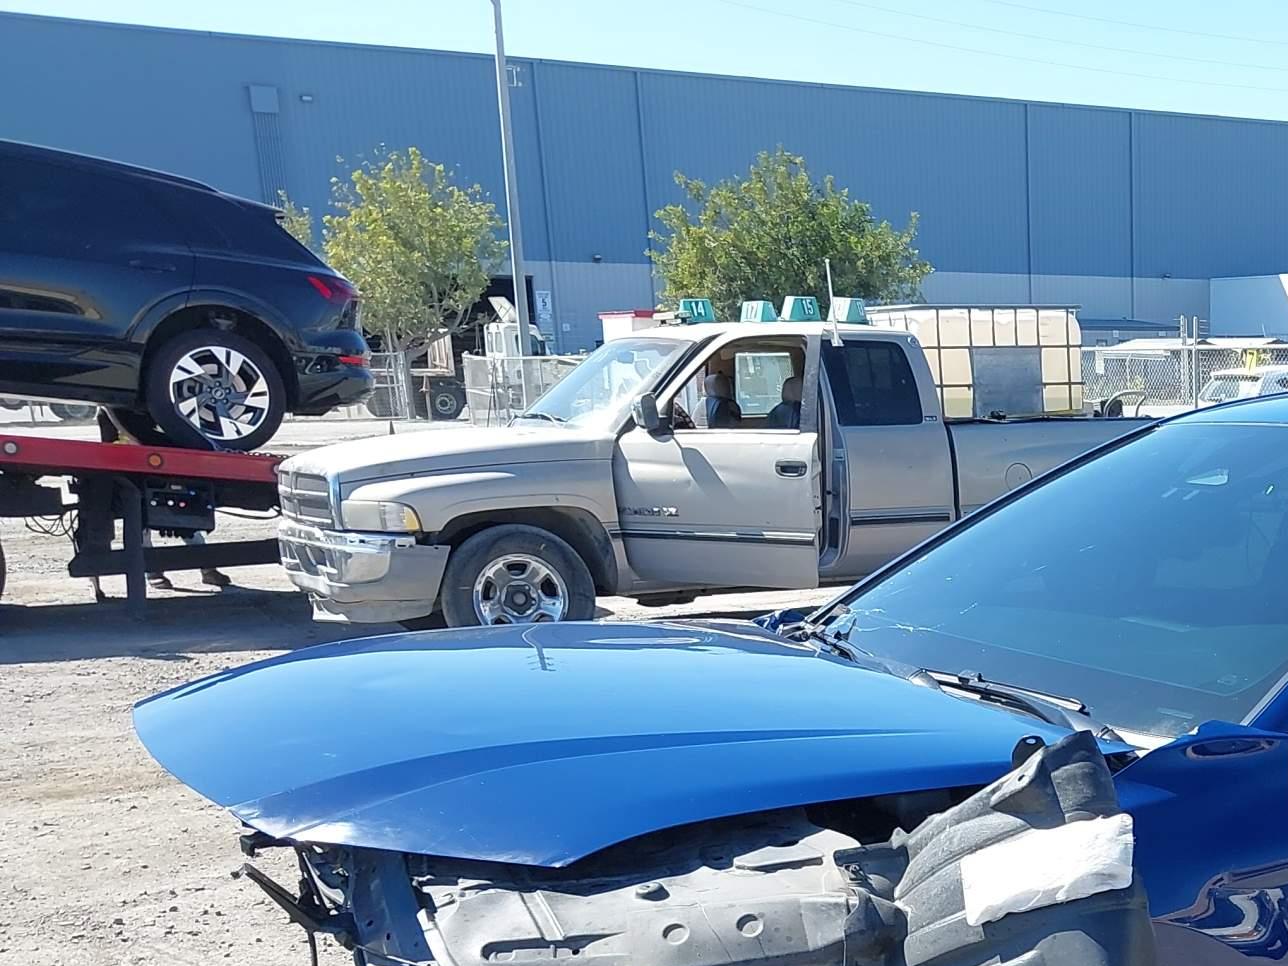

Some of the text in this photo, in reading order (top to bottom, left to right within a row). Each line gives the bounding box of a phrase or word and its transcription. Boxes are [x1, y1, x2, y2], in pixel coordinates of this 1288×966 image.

[691, 301, 705, 317] 14
[802, 299, 814, 315] 15
[1248, 351, 1255, 371] 7
